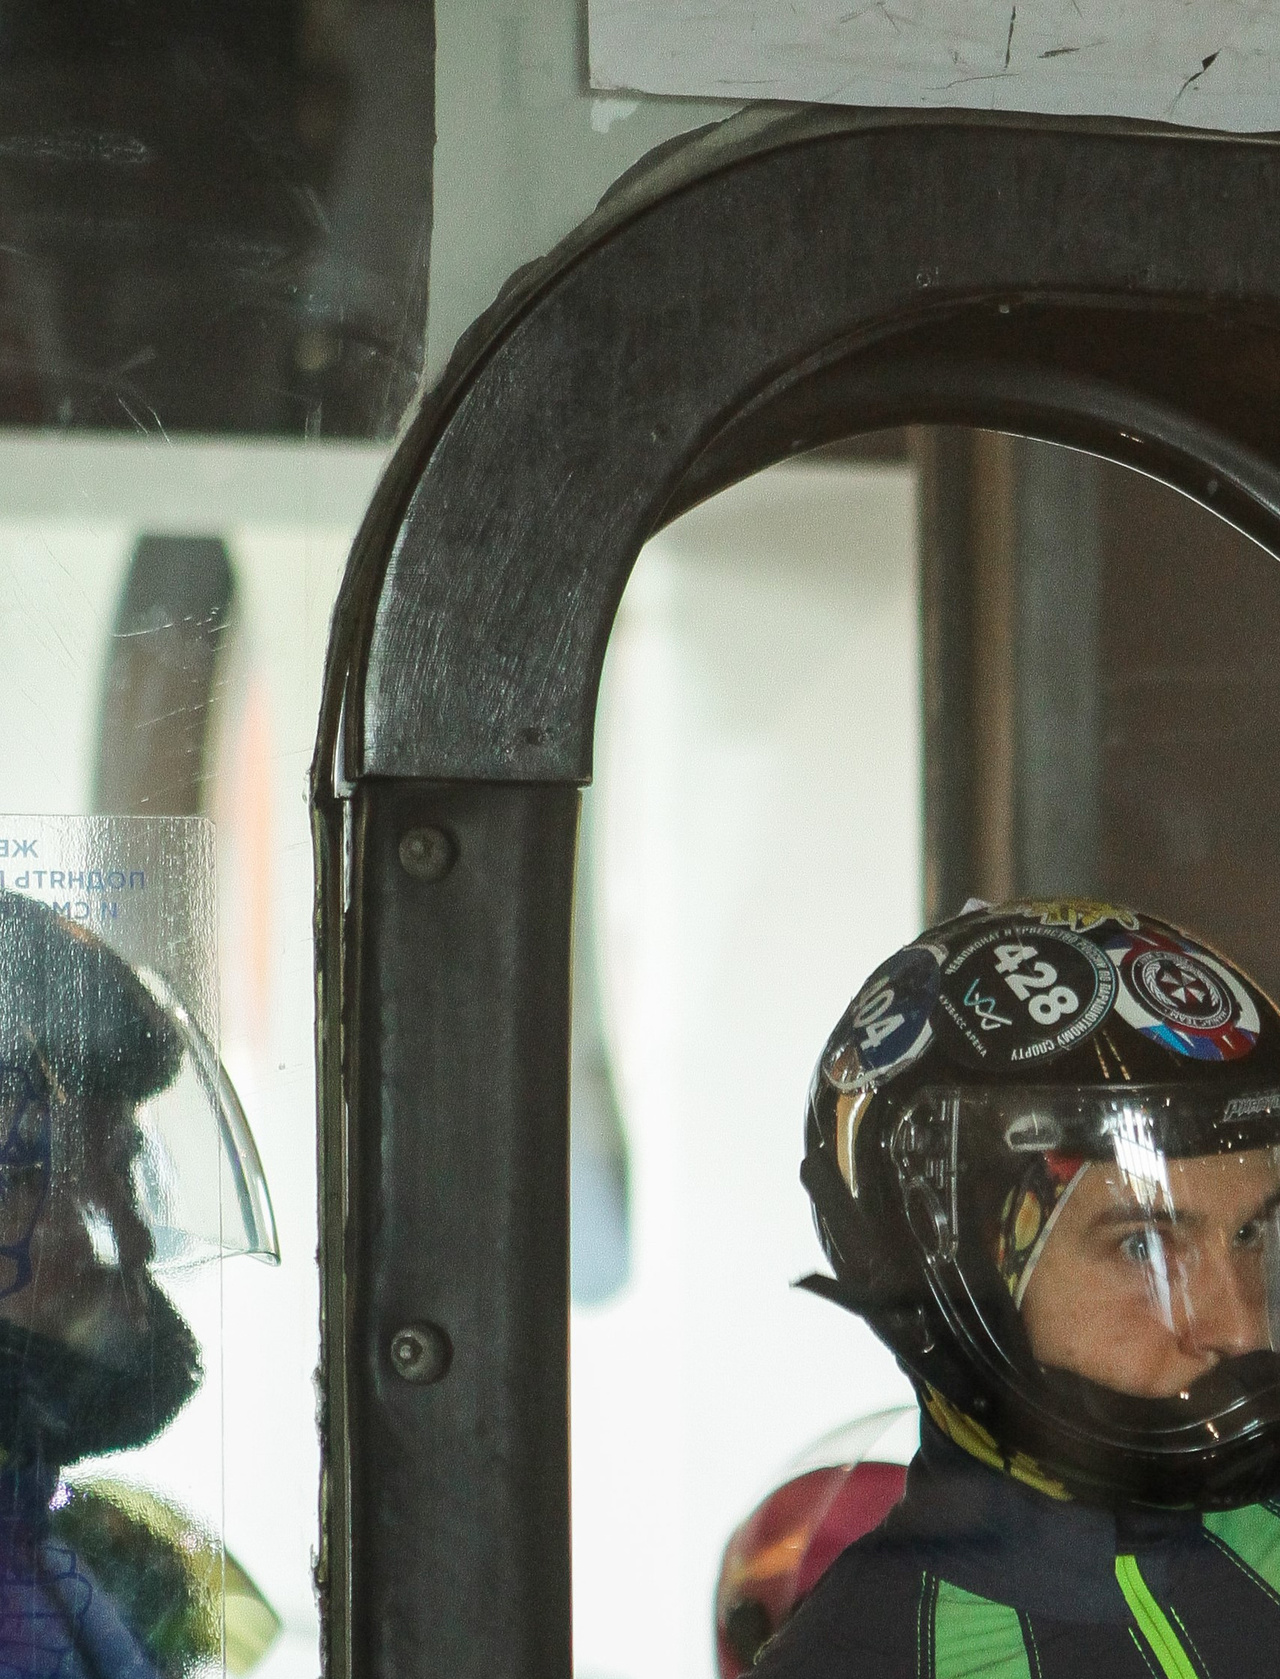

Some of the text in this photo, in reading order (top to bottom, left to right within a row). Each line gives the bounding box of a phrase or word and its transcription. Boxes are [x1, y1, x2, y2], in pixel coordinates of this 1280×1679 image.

[944, 932, 1002, 975] ЧЕМПИОНАТ
[1010, 1042, 1056, 1061] СПОРТУ
[993, 944, 1079, 1026] 428
[1169, 1009, 1199, 1027] TEAM
[939, 994, 988, 1058] КУЗБАСС АРЕНА
